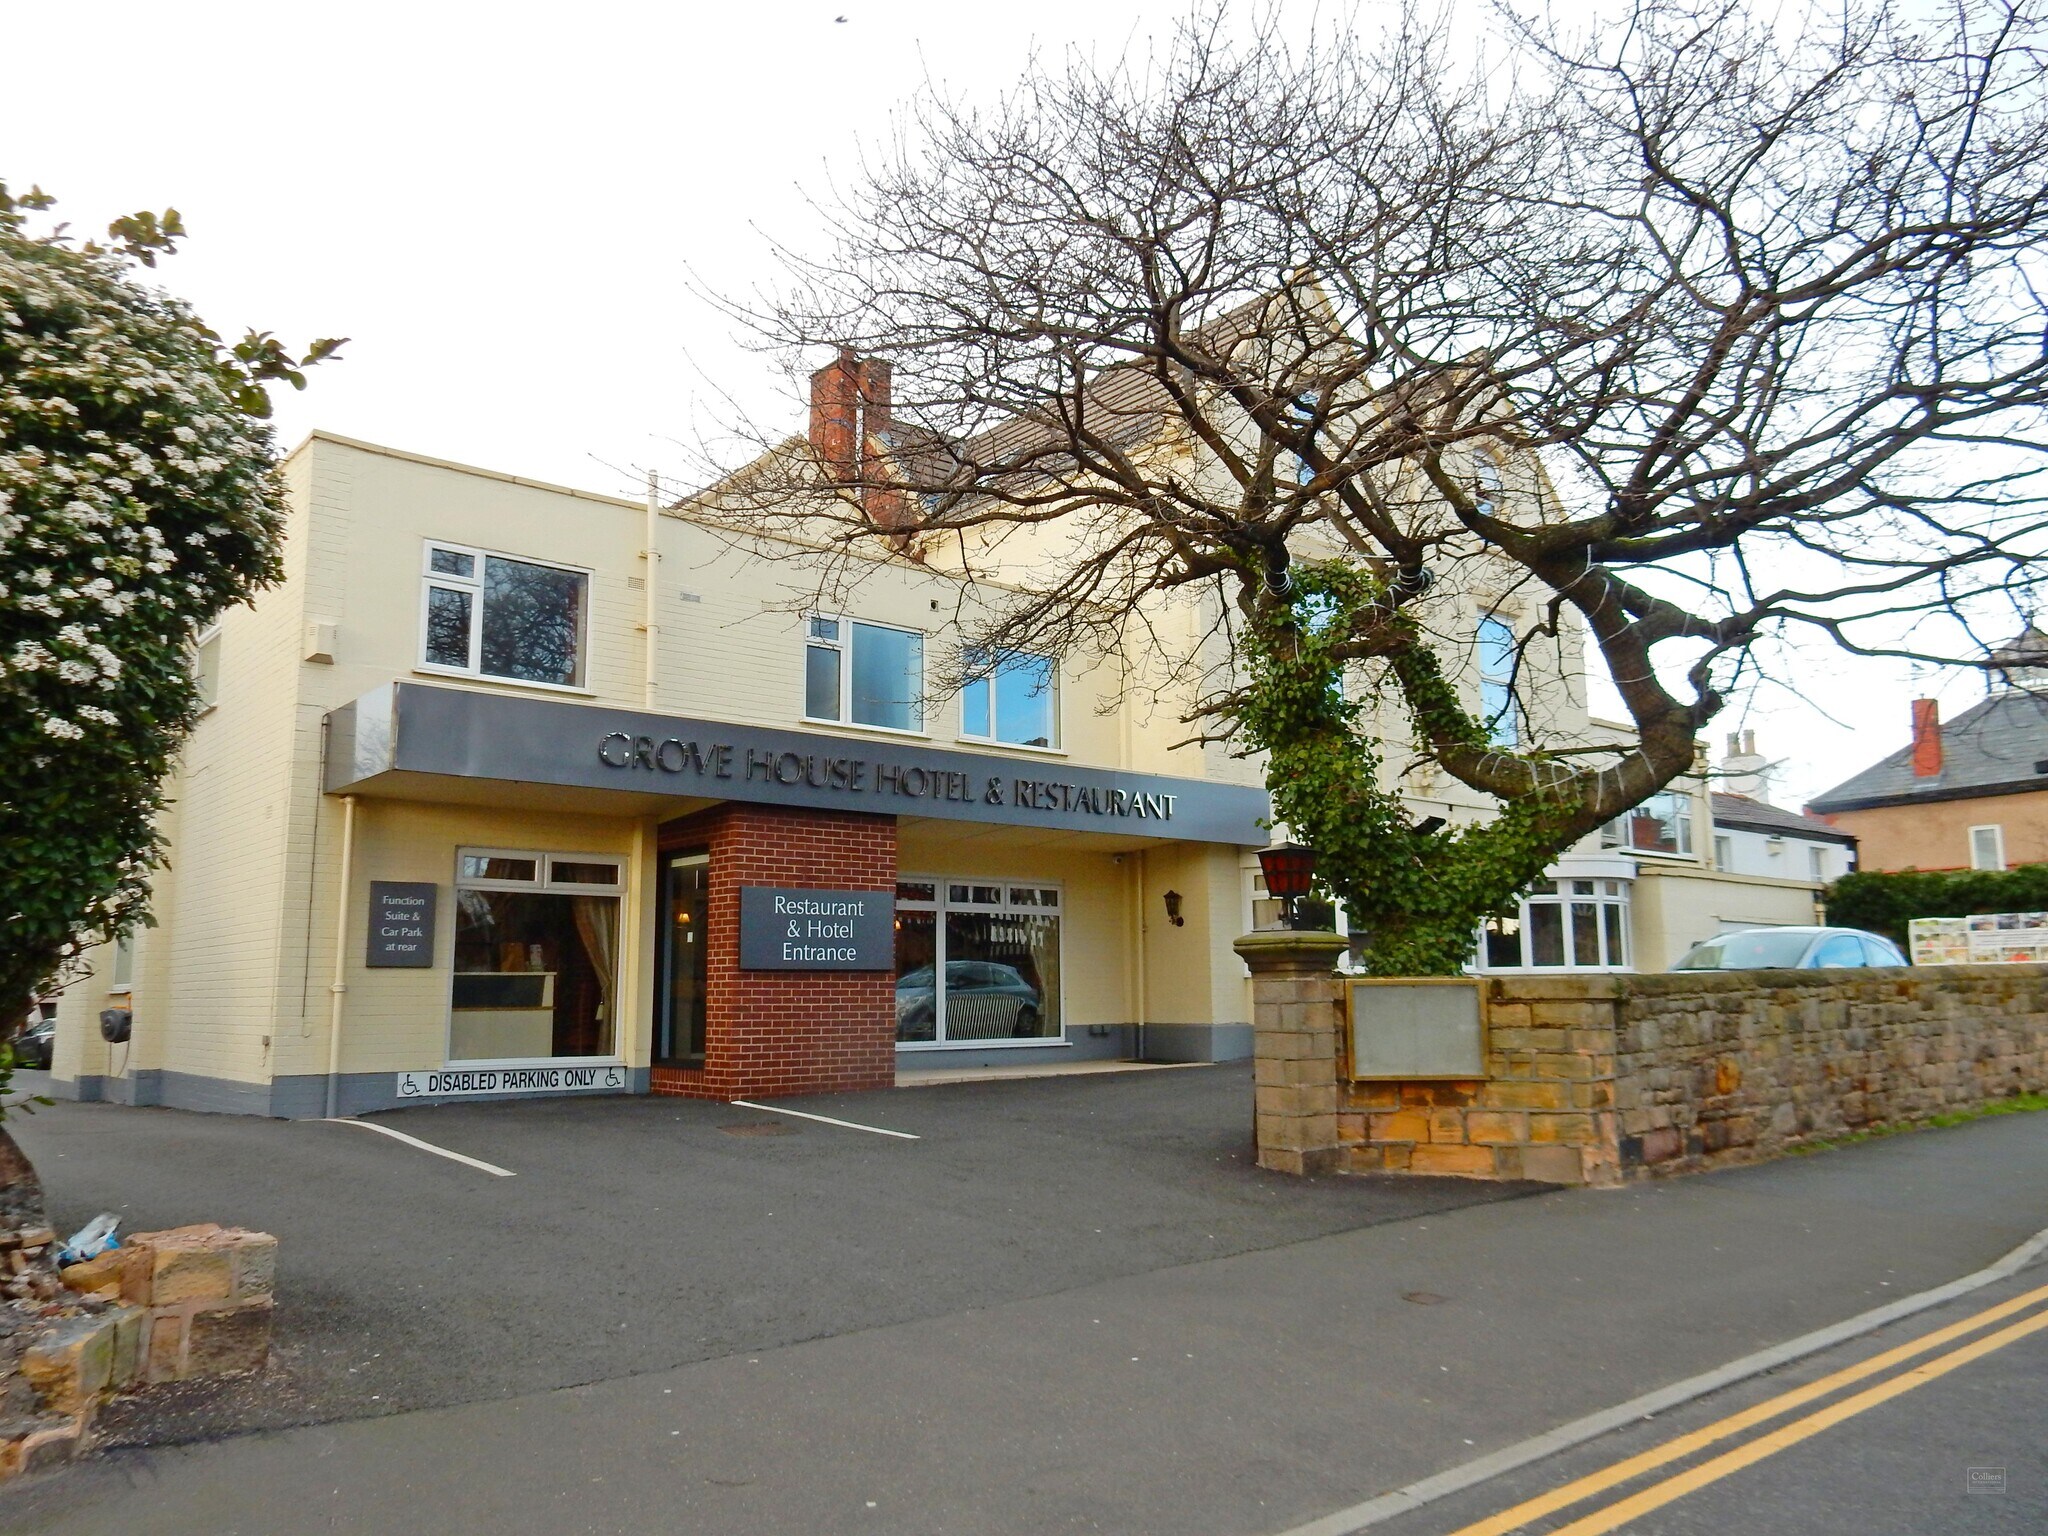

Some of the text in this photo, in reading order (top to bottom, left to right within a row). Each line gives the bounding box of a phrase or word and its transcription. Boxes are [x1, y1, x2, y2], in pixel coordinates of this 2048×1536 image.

[599, 731, 1178, 820] GROVE HOUSE HOTEL & RESTAURANT
[382, 895, 425, 906] Function
[774, 895, 865, 917] Restaurant
[385, 910, 420, 921] Suite &
[381, 926, 423, 937] Car Park
[787, 919, 854, 939] & Hotel
[385, 943, 395, 951] at
[783, 942, 857, 961] Entrance
[428, 1069, 597, 1092] DISABLED PARKING ONLY
